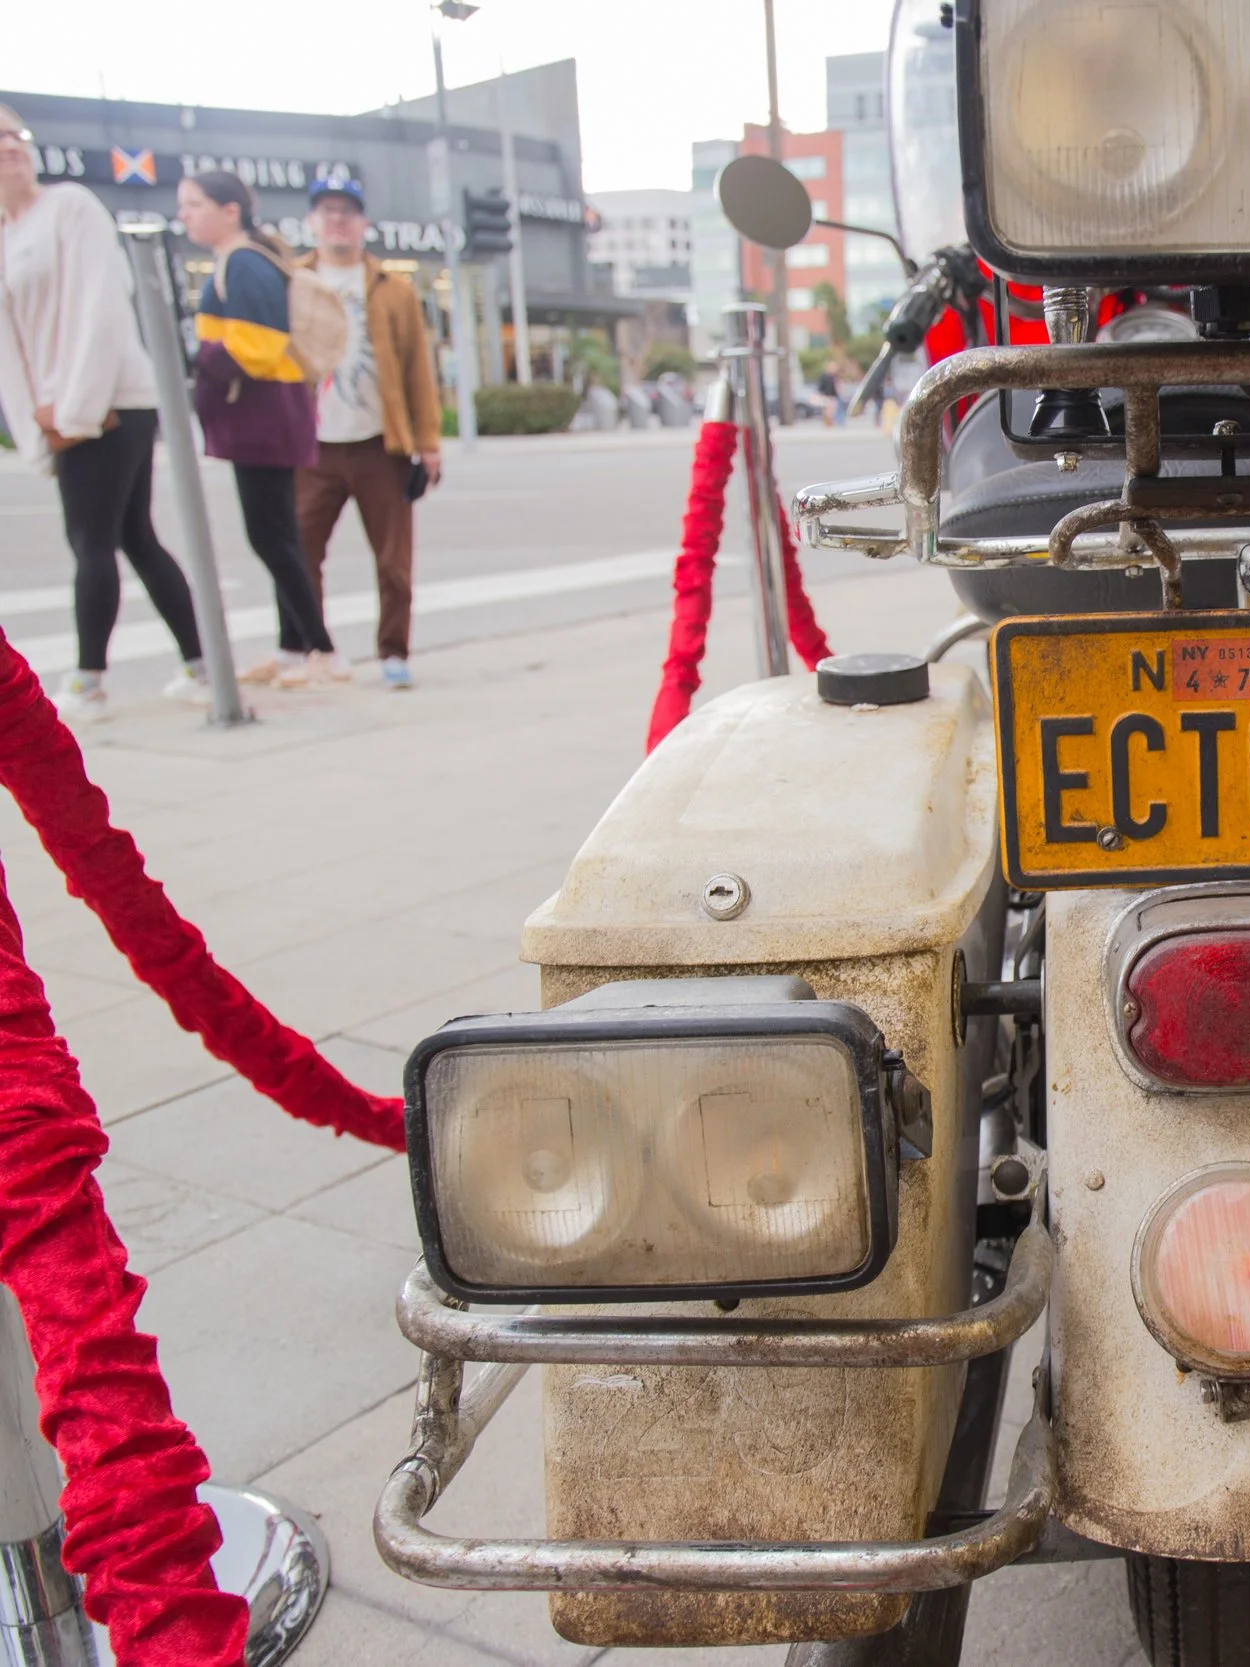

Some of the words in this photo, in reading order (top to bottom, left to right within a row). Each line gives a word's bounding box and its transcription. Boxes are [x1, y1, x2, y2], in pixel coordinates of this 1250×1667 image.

[376, 220, 467, 252] TRAD
[1182, 646, 1209, 661] NY
[1131, 649, 1166, 691] N
[1186, 668, 1200, 693] 4
